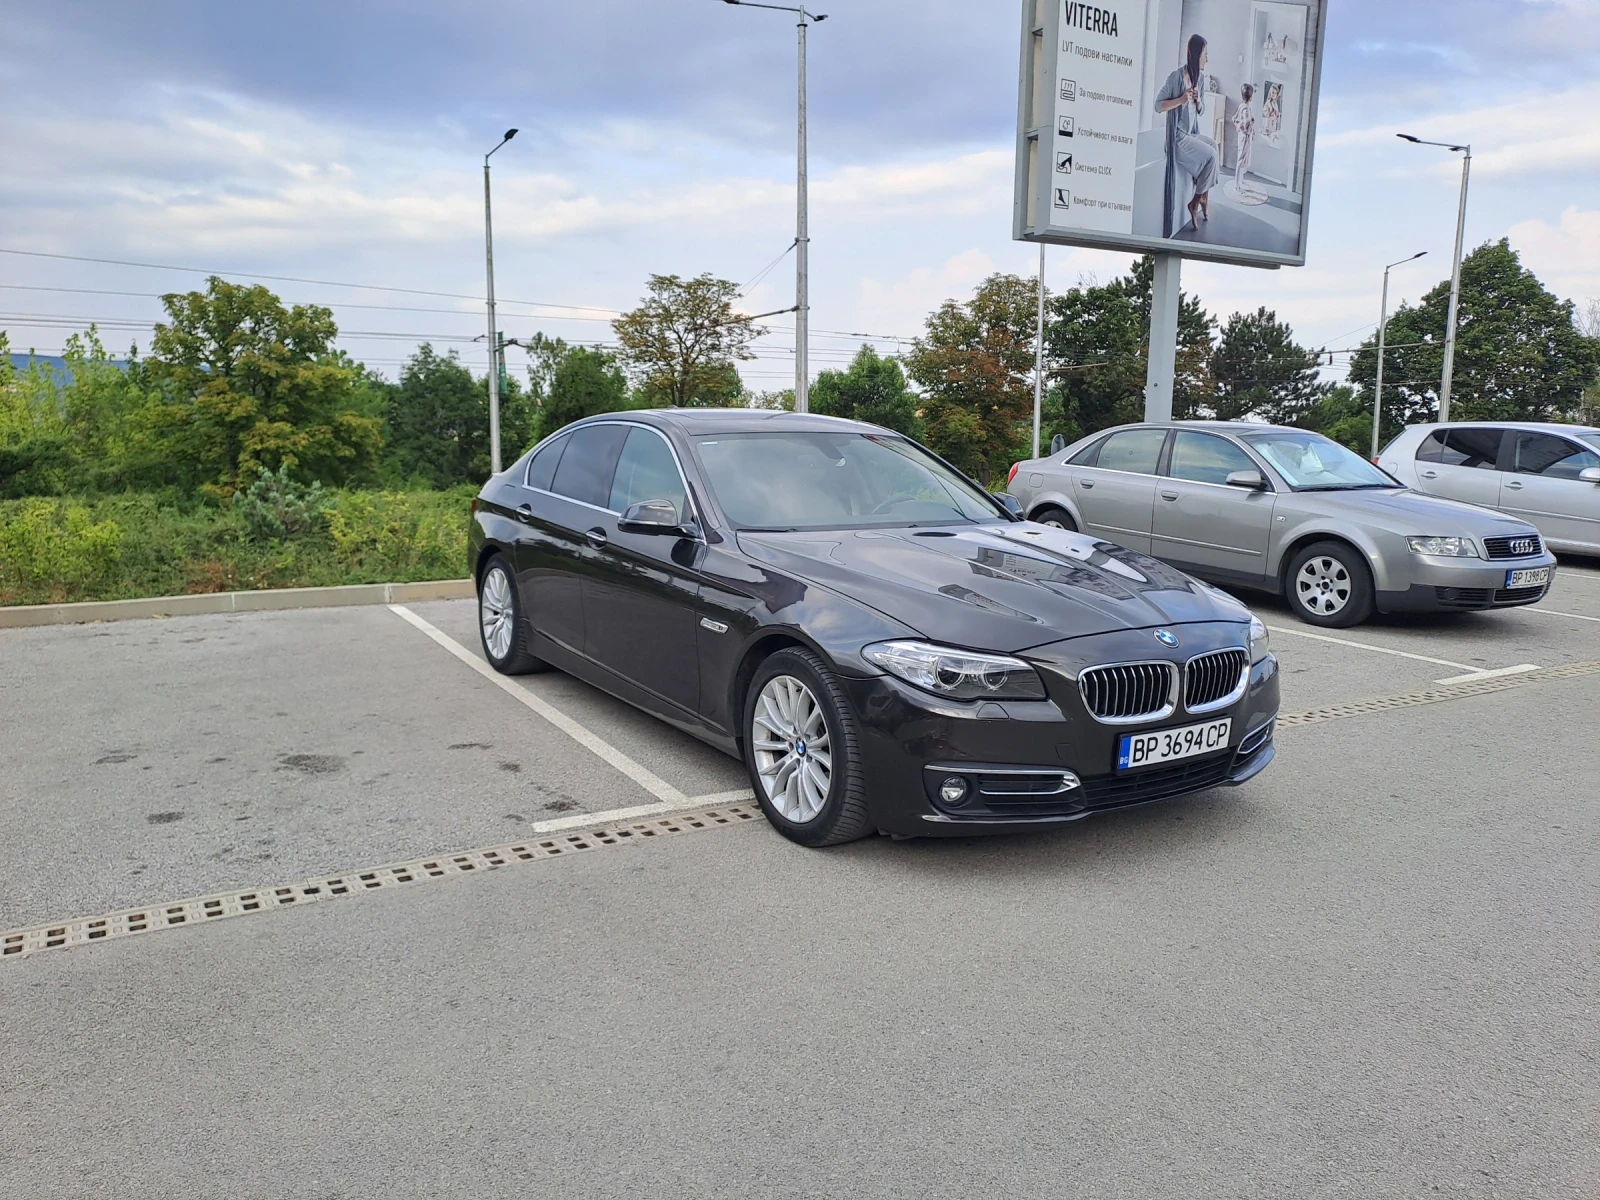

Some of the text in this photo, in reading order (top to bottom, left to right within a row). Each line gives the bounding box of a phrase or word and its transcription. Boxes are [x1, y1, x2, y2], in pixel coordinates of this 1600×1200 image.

[1065, 0, 1118, 37] VITERRA
[1062, 40, 1133, 67] LVT подови настилки
[1075, 162, 1098, 174] Система
[1161, 727, 1204, 758] 3694
